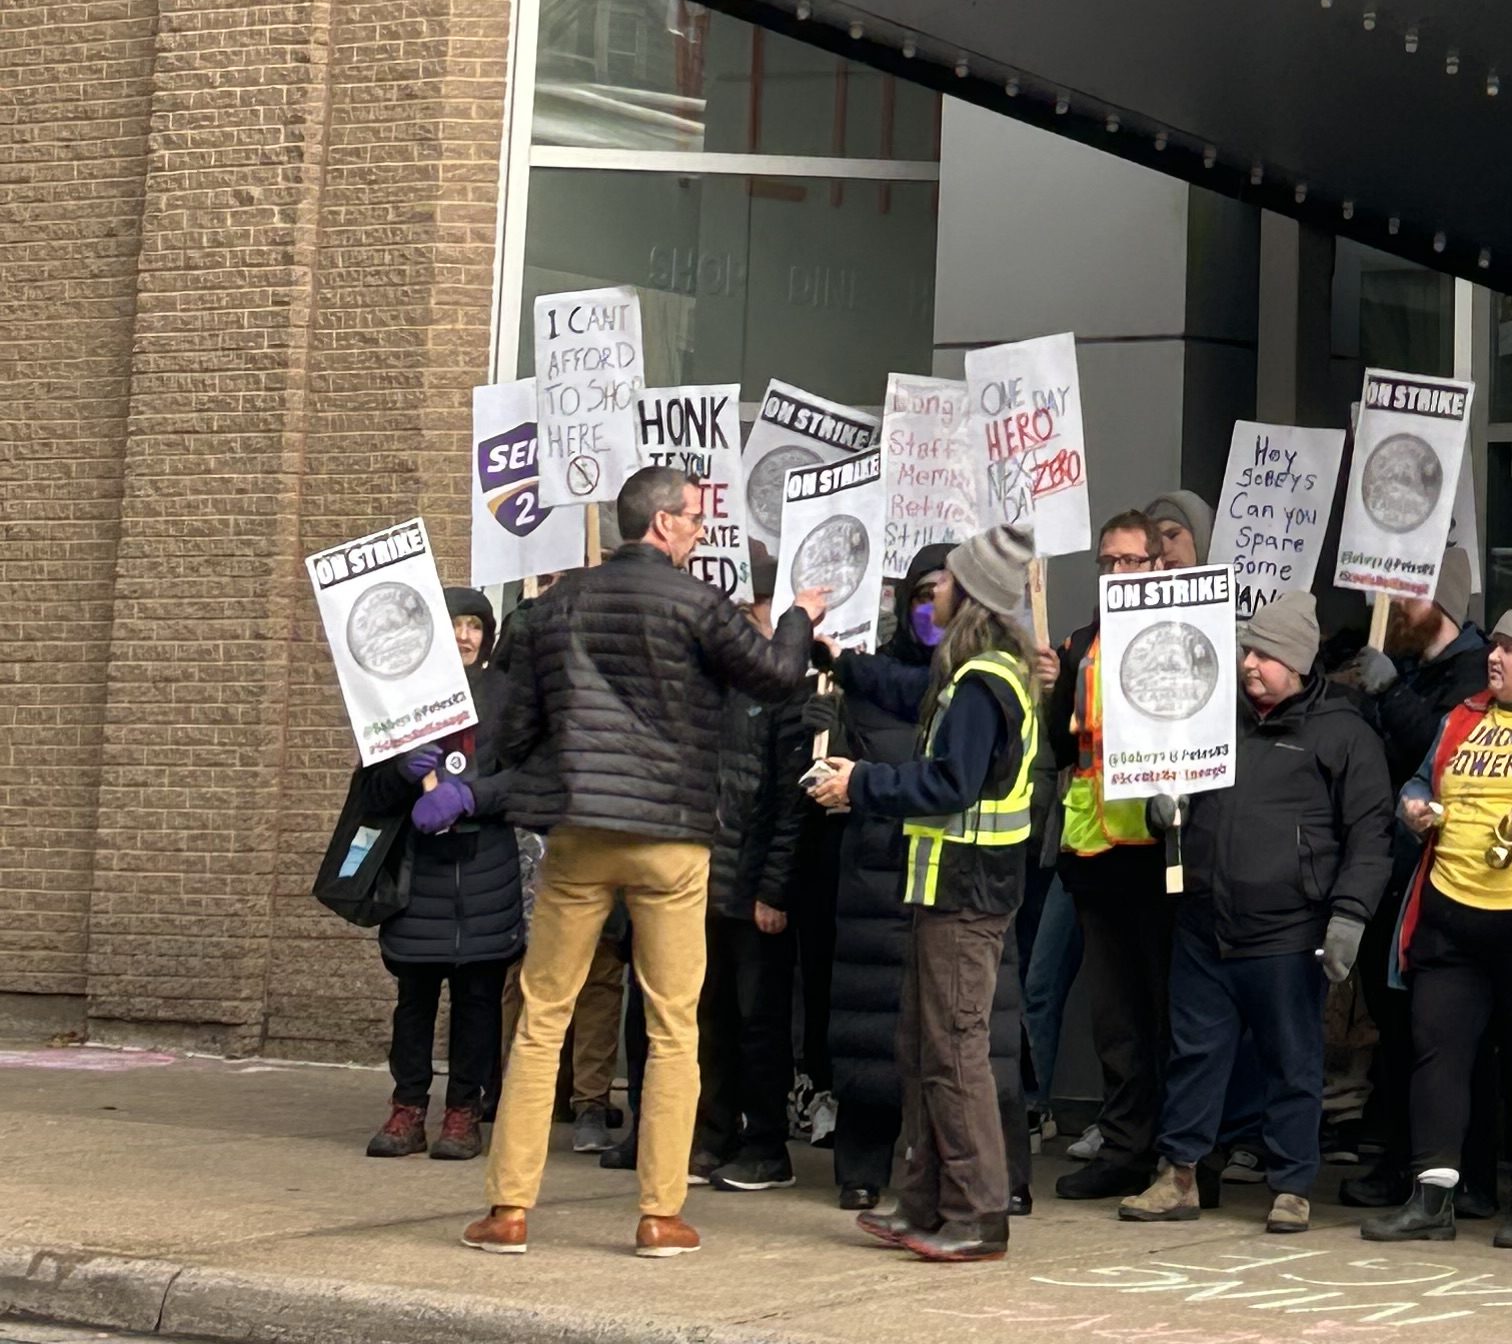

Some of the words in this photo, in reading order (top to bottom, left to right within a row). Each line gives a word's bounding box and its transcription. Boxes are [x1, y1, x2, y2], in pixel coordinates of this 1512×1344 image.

[548, 309, 560, 340] I
[548, 341, 636, 380] AFFORD
[544, 382, 581, 416] TO
[980, 376, 1025, 416] ONE
[1366, 380, 1393, 408] ON
[1393, 384, 1466, 417] STRIKE
[547, 422, 611, 458] HERE
[637, 395, 730, 449] HONK
[765, 396, 796, 425] ON
[794, 408, 870, 450] STRIKE
[985, 407, 1054, 462] HERO
[487, 438, 537, 473] SEI
[787, 471, 817, 499] ON
[819, 453, 880, 494] STRIKE
[513, 491, 537, 526] 2
[1229, 491, 1275, 520] Can
[316, 552, 349, 585] ON
[350, 527, 425, 574] STRIKE
[1235, 525, 1305, 557] Spare
[1234, 555, 1294, 581] Some
[1108, 583, 1141, 610] ON
[1143, 573, 1230, 607] STRIKE
